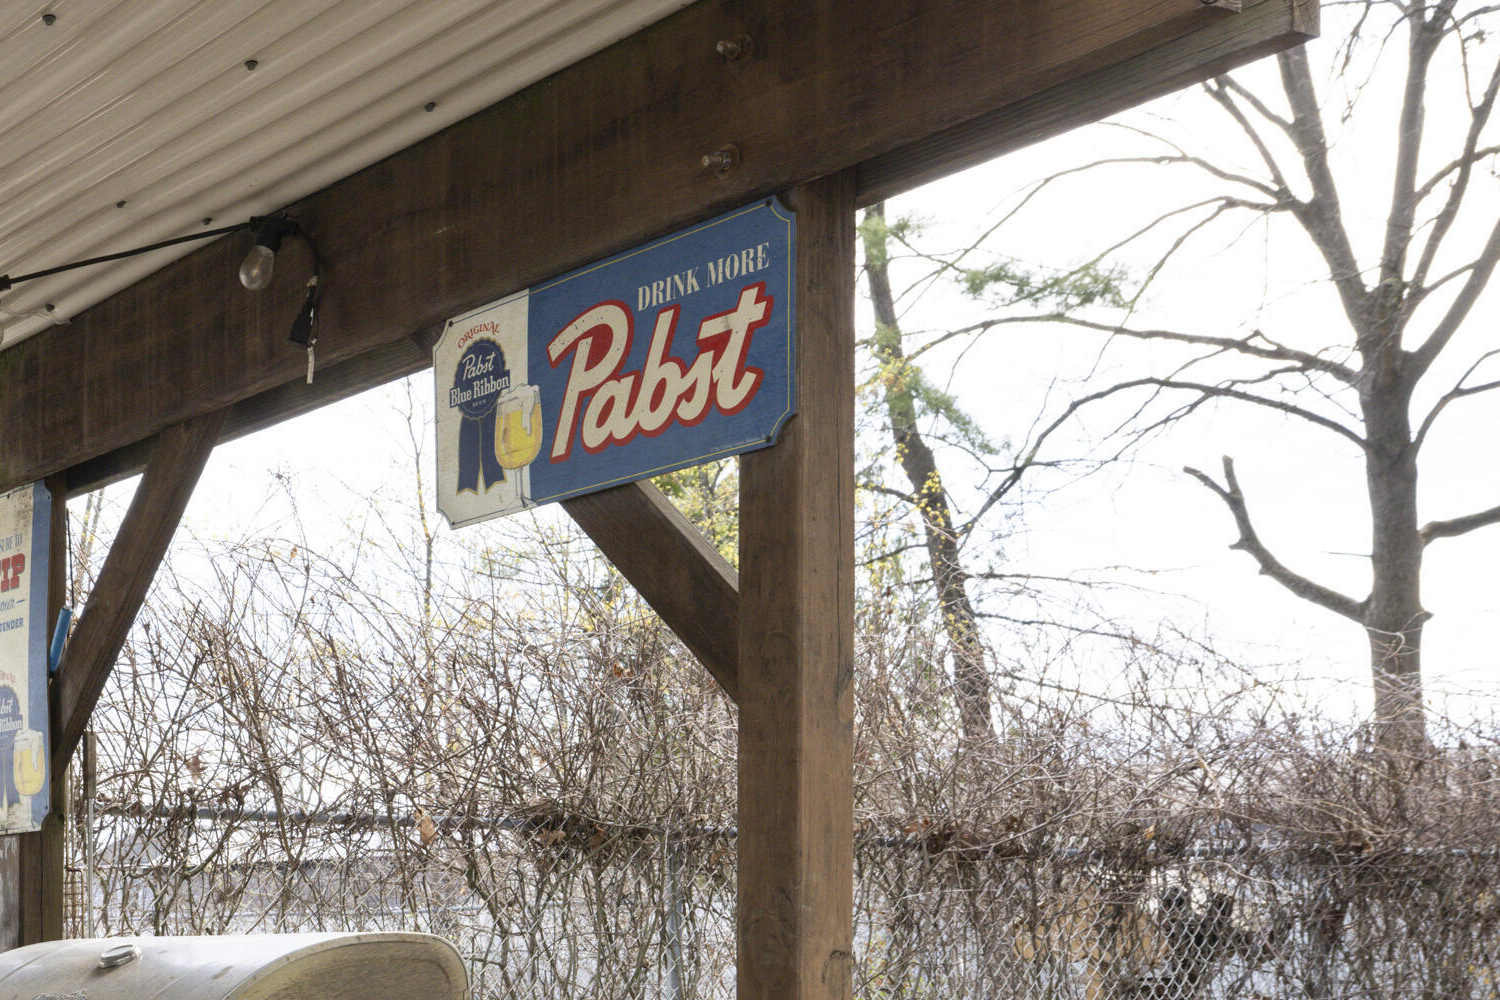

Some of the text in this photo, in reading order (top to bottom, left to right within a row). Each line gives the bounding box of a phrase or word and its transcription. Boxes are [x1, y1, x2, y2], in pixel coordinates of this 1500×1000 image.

[637, 242, 770, 312] DRINK MORE
[457, 321, 500, 349] ORIGINAL
[462, 351, 496, 381] Pabst
[547, 284, 771, 461] Pabst
[450, 376, 510, 407] Blue Ribbon
